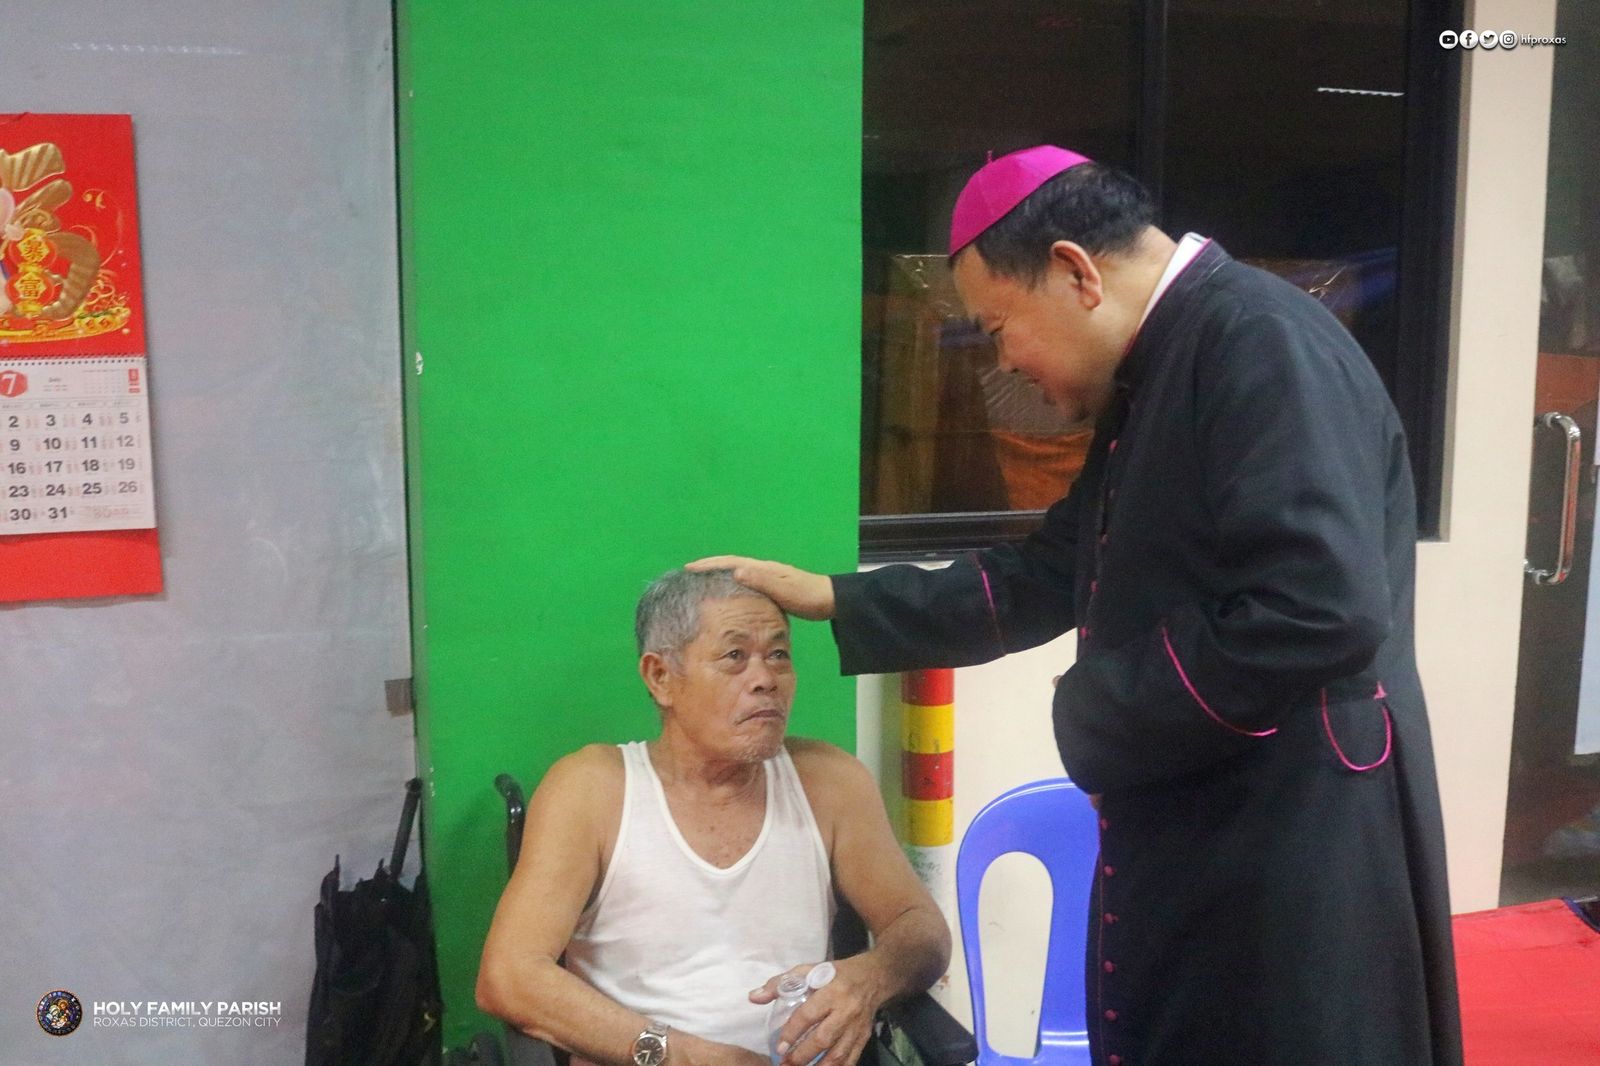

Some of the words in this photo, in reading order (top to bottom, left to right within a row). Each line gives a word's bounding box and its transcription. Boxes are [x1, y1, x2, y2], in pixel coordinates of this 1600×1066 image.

[1, 373, 17, 395] 7
[8, 415, 19, 428] 2
[46, 414, 56, 427] 3
[82, 413, 93, 426] 4
[119, 412, 129, 424] 5
[10, 439, 20, 451] 9
[43, 437, 61, 450] 10
[81, 436, 98, 449] 11
[117, 435, 134, 447] 12
[8, 462, 26, 474] 16
[45, 460, 63, 473] 17
[82, 459, 100, 472] 18
[118, 458, 135, 470] 19
[9, 485, 29, 498] 23
[46, 484, 66, 496] 24
[82, 482, 102, 495] 25
[119, 481, 137, 493] 26
[10, 508, 31, 521] 30
[48, 507, 67, 519] 31
